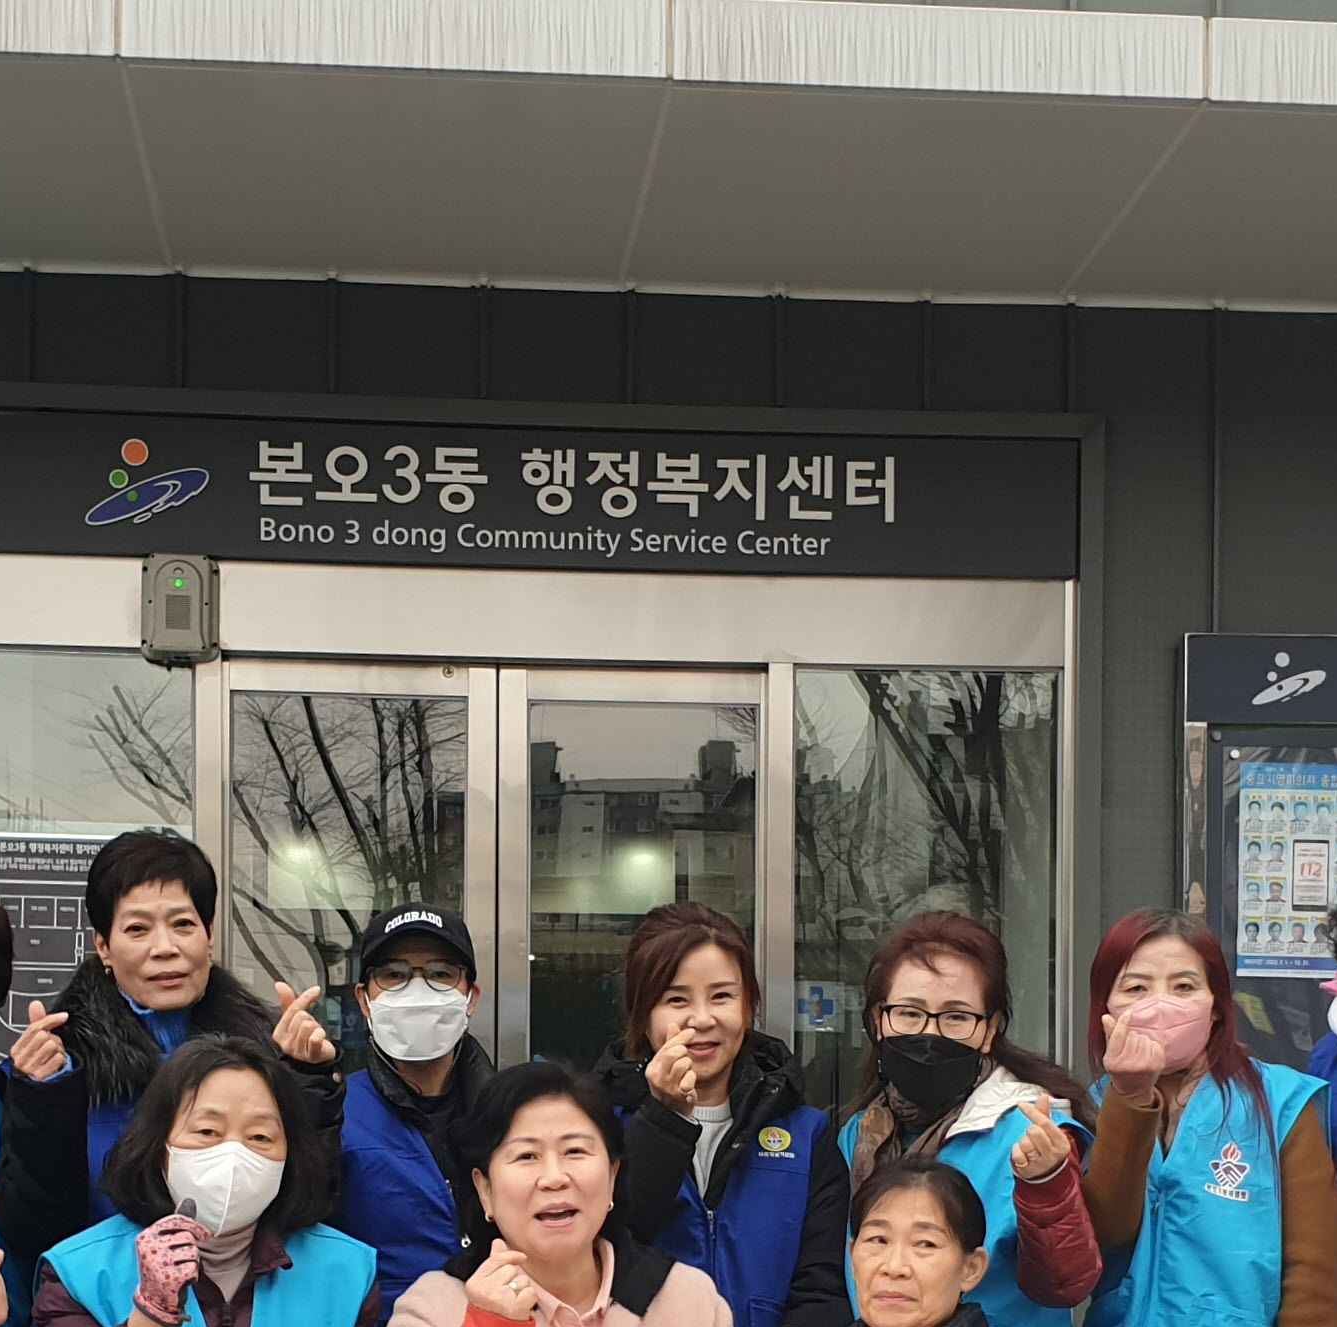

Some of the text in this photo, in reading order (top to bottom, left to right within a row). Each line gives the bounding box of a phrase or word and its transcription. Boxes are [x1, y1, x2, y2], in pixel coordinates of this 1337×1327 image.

[250, 441, 896, 523] 본오3동 행정복지센터
[259, 518, 831, 559] Bono 3 dong Community Service Center
[1300, 862, 1323, 877] 112
[385, 910, 443, 933] COLORADO
